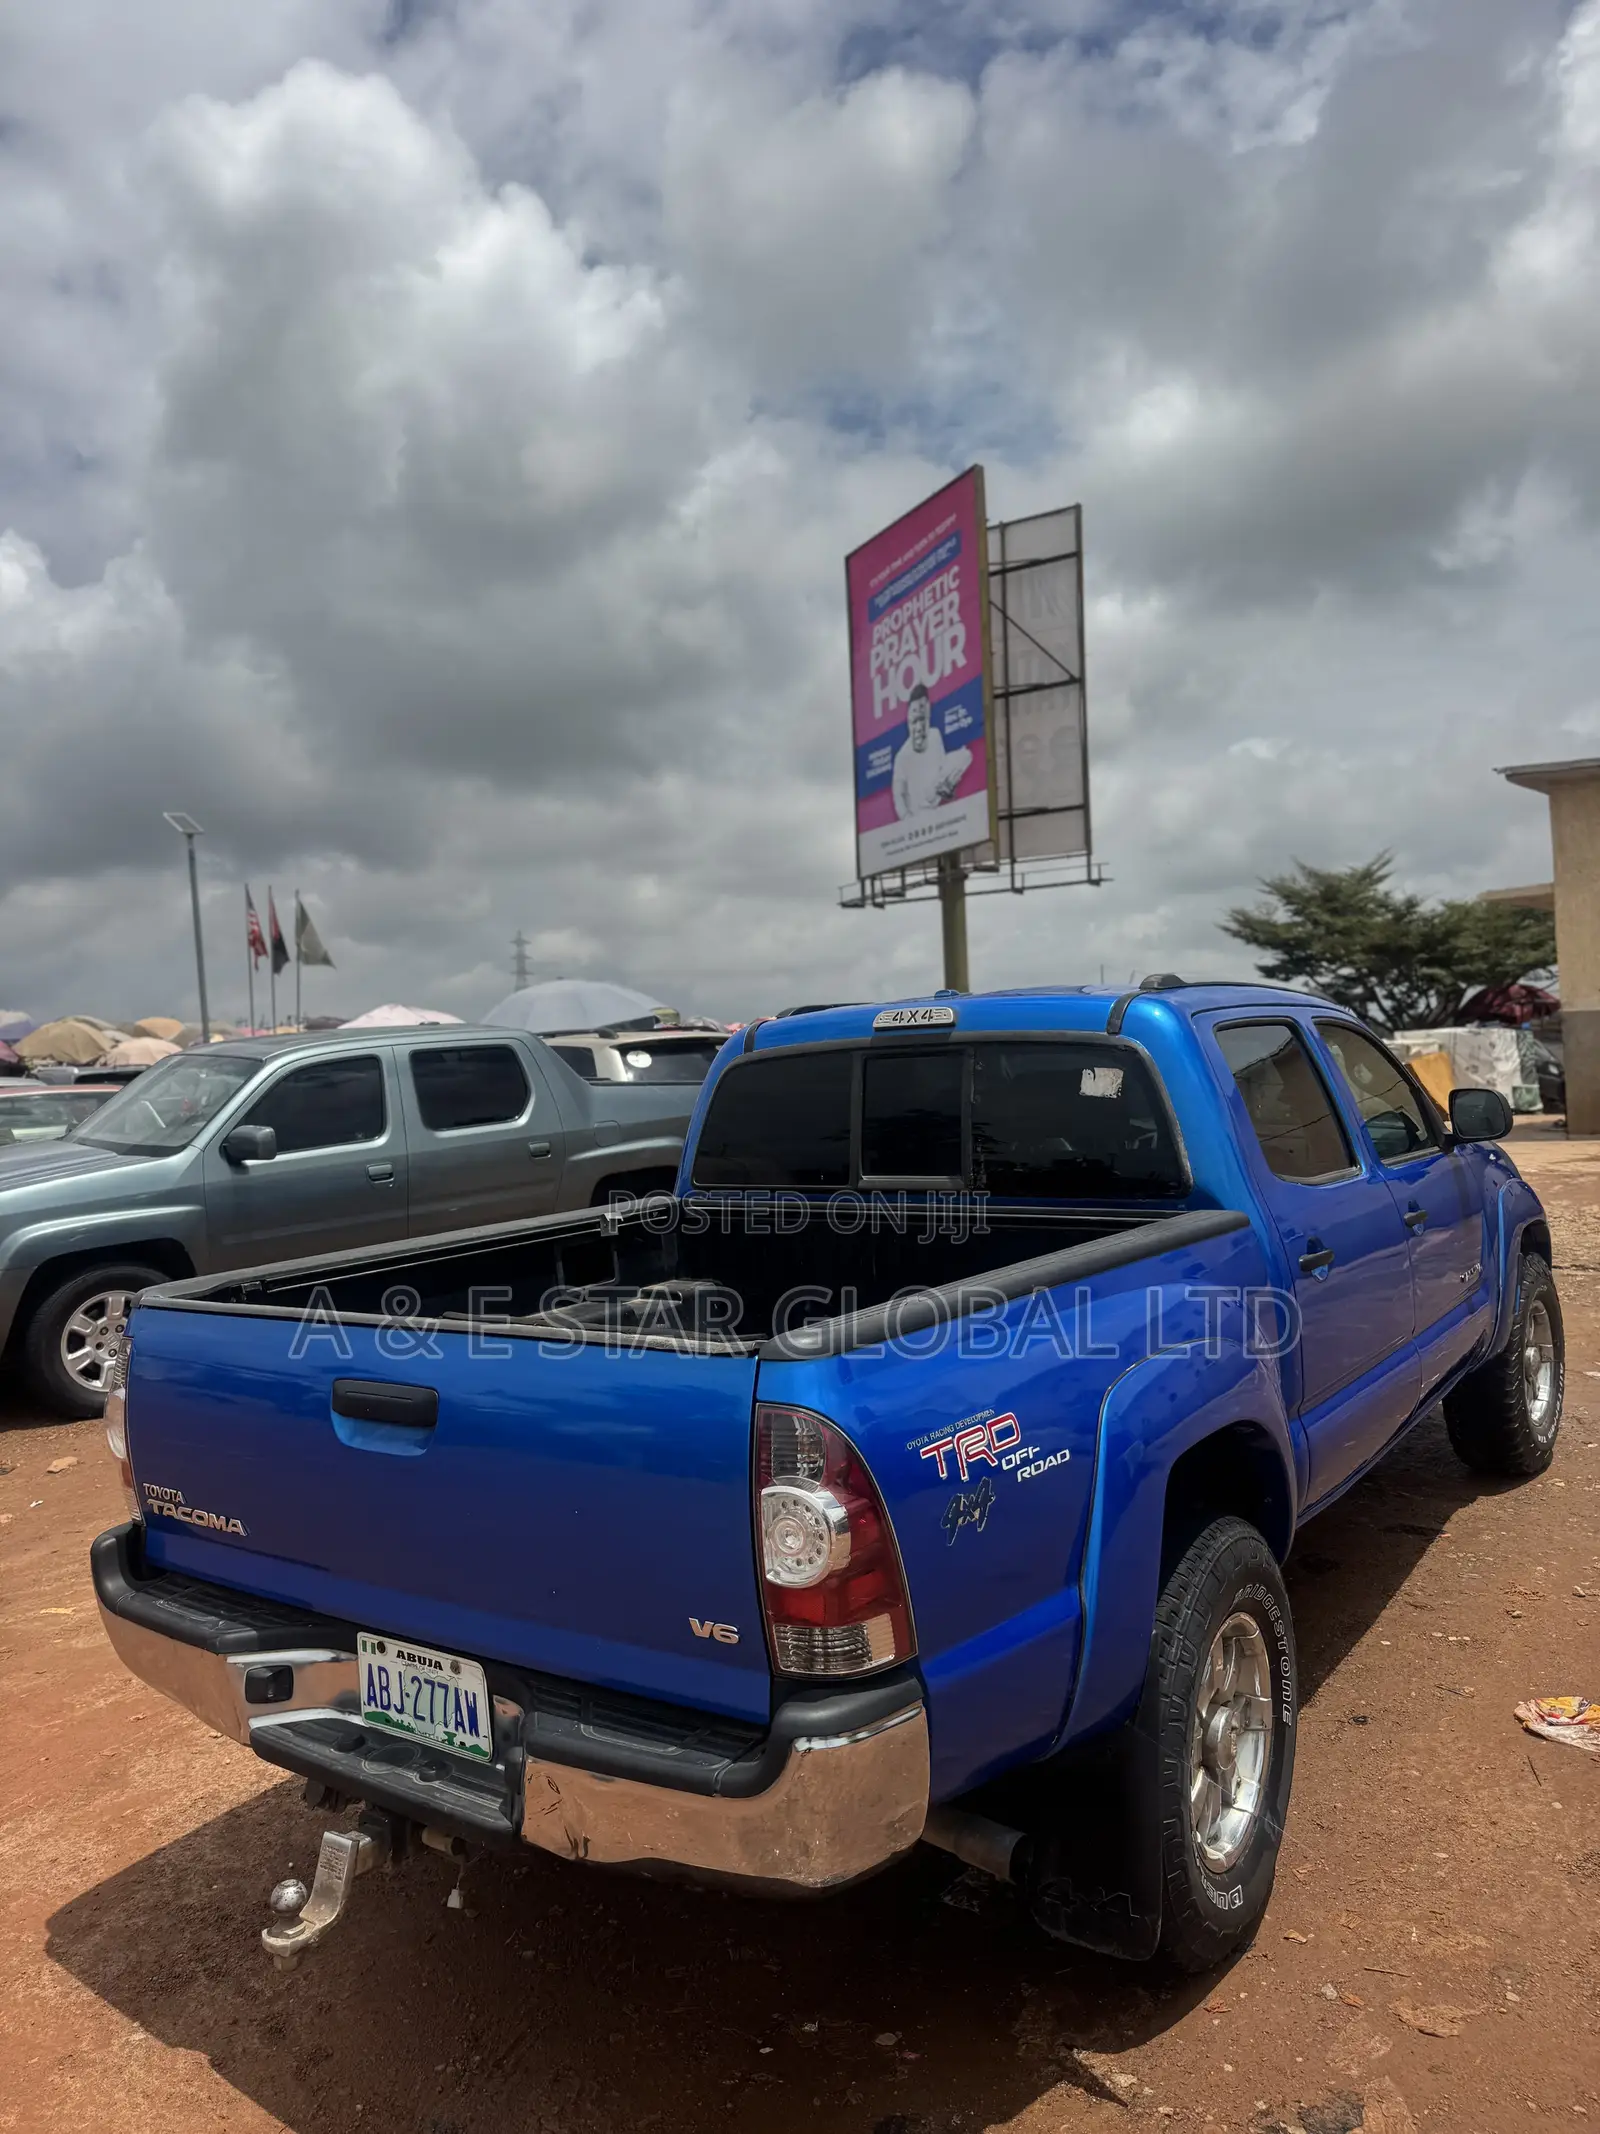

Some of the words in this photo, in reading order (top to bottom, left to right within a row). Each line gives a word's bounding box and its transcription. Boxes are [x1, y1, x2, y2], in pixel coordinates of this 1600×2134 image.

[873, 565, 960, 646] PROPHETIC
[870, 590, 962, 679] PRAYER
[873, 622, 967, 720] HOUR
[905, 1435, 930, 1451] OYOTA
[930, 1424, 955, 1440] RACING
[955, 1408, 995, 1430] DEVELOPMEN
[920, 1411, 1021, 1482] TRD
[1001, 1446, 1041, 1471] OFF
[1017, 1449, 1071, 1483] ROAD
[143, 1482, 186, 1505] TOYOTA
[146, 1498, 248, 1536] TACOMA
[688, 1617, 740, 1644] V6
[396, 1649, 444, 1671] ABUJA
